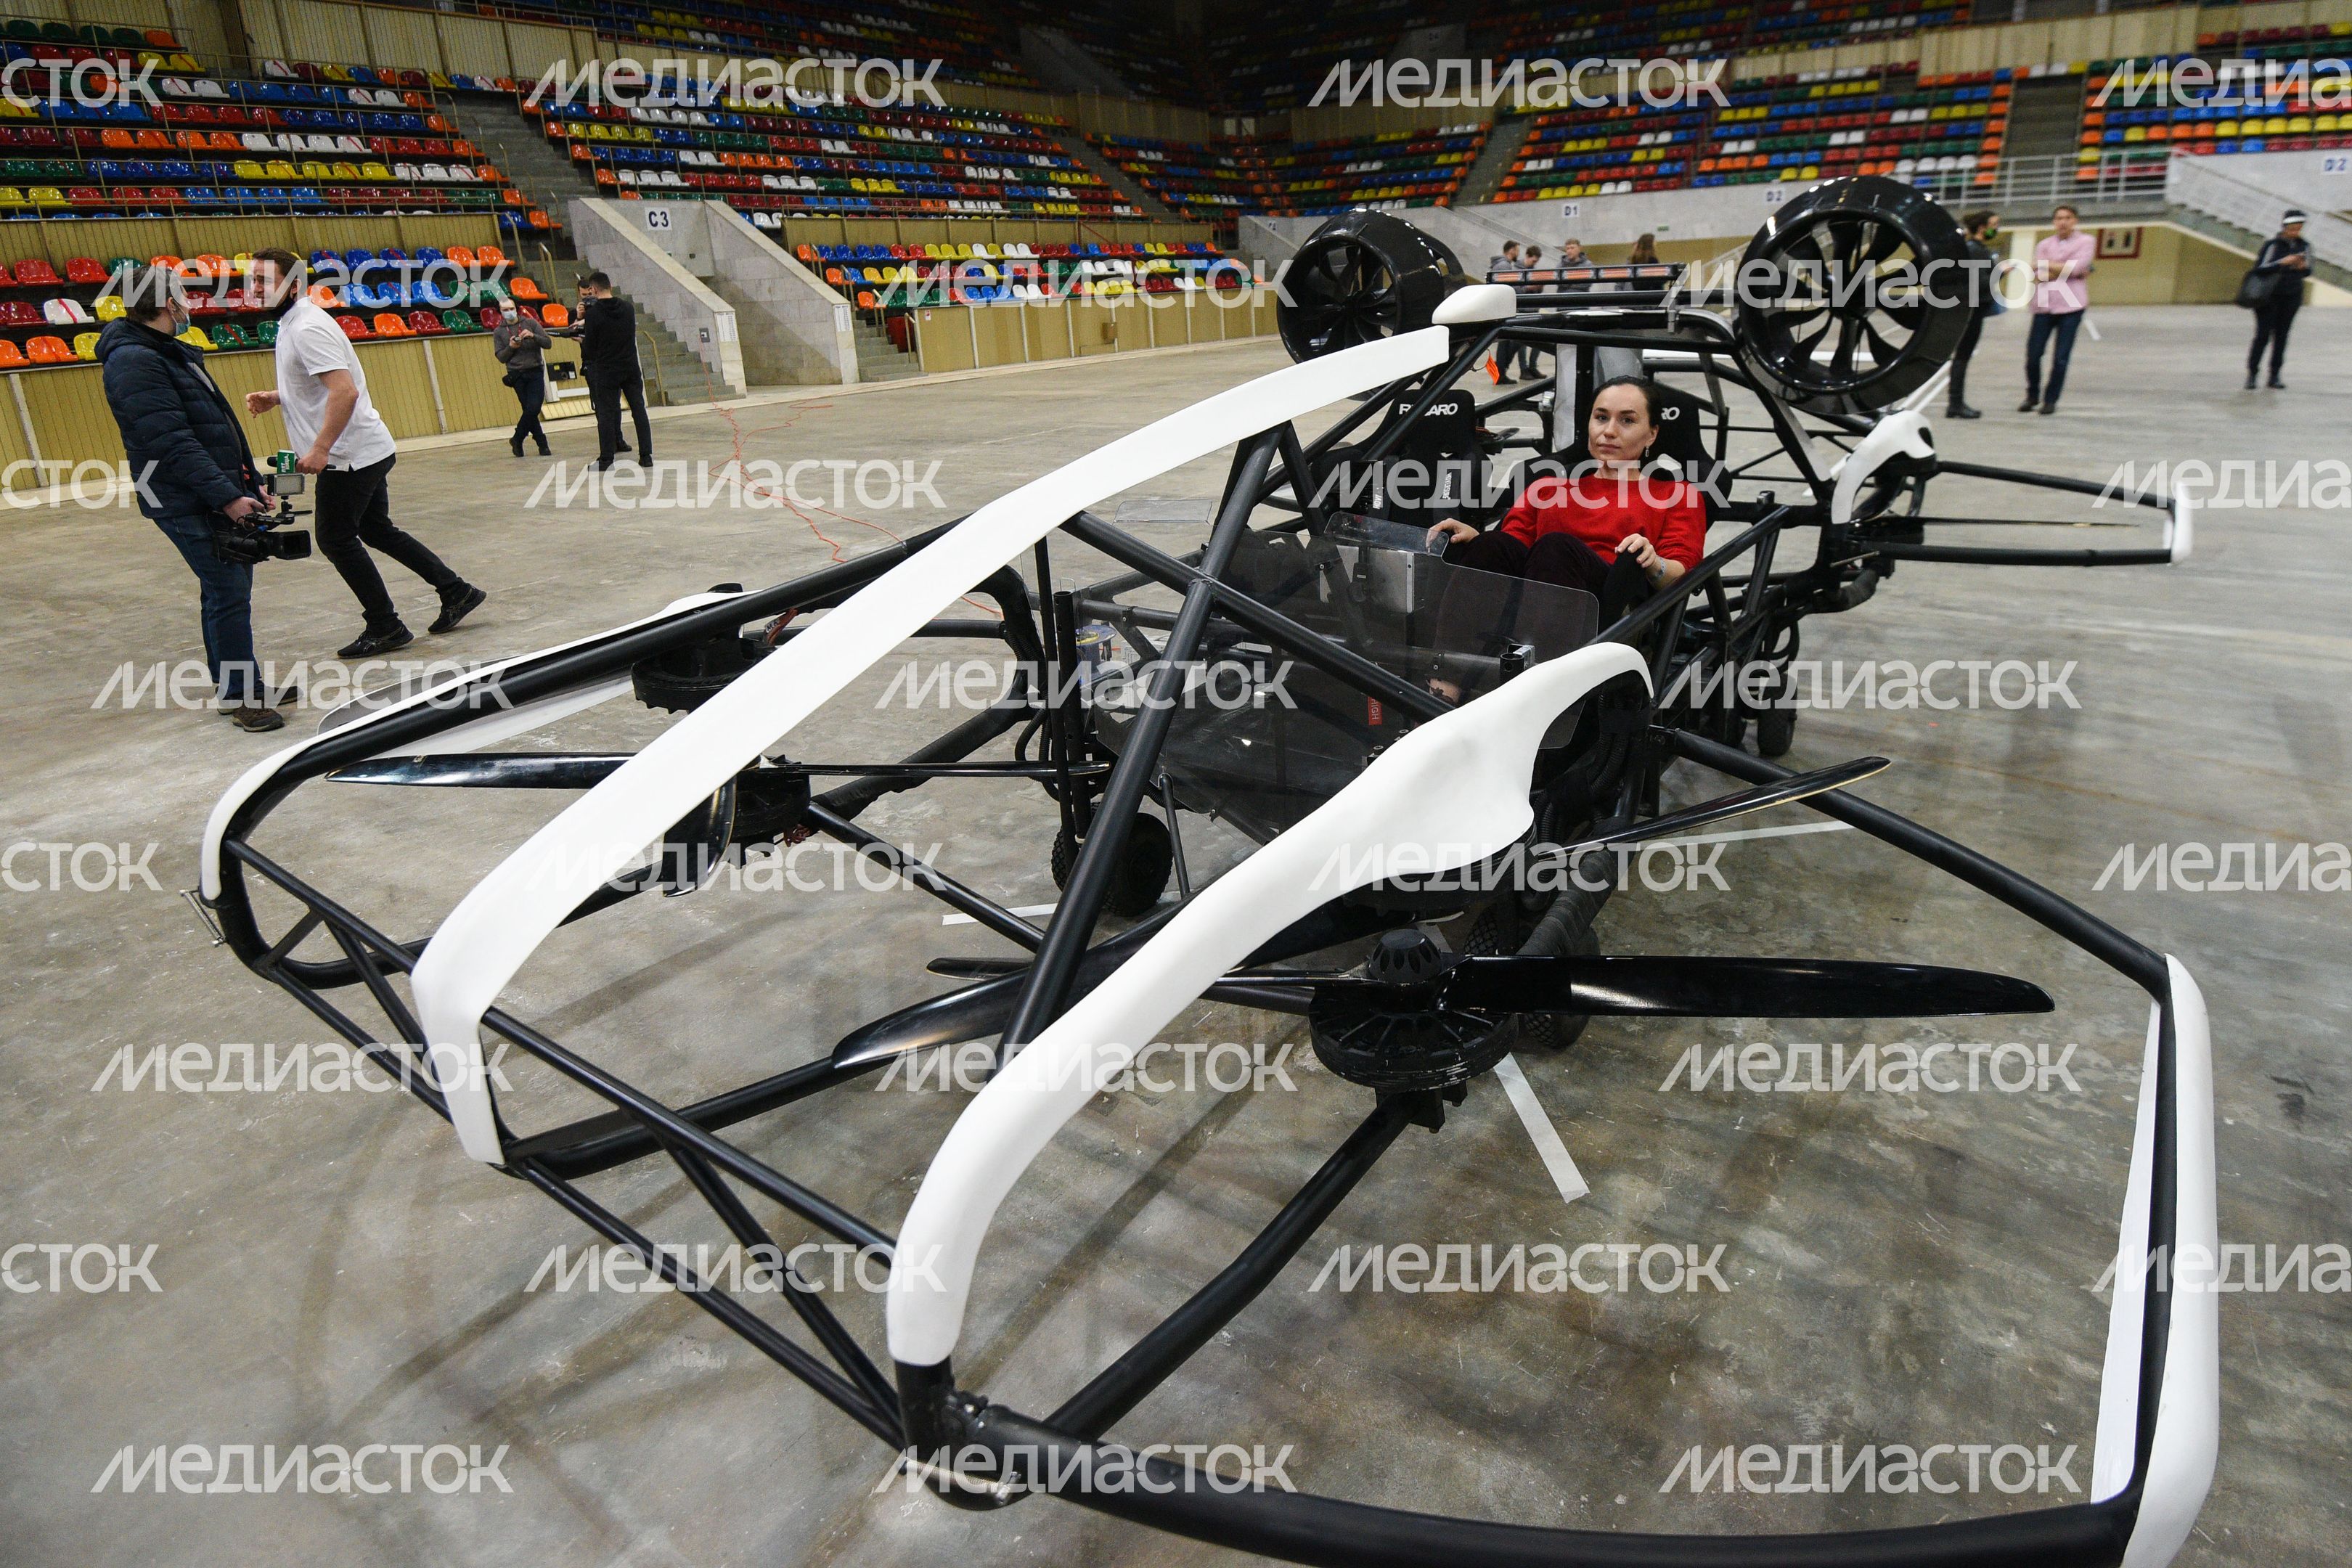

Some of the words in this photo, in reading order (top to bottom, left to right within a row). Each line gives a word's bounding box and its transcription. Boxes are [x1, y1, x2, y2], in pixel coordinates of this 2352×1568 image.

[1565, 205, 1577, 216] D1
[648, 211, 669, 227] C3
[1399, 403, 1458, 417] RARO
